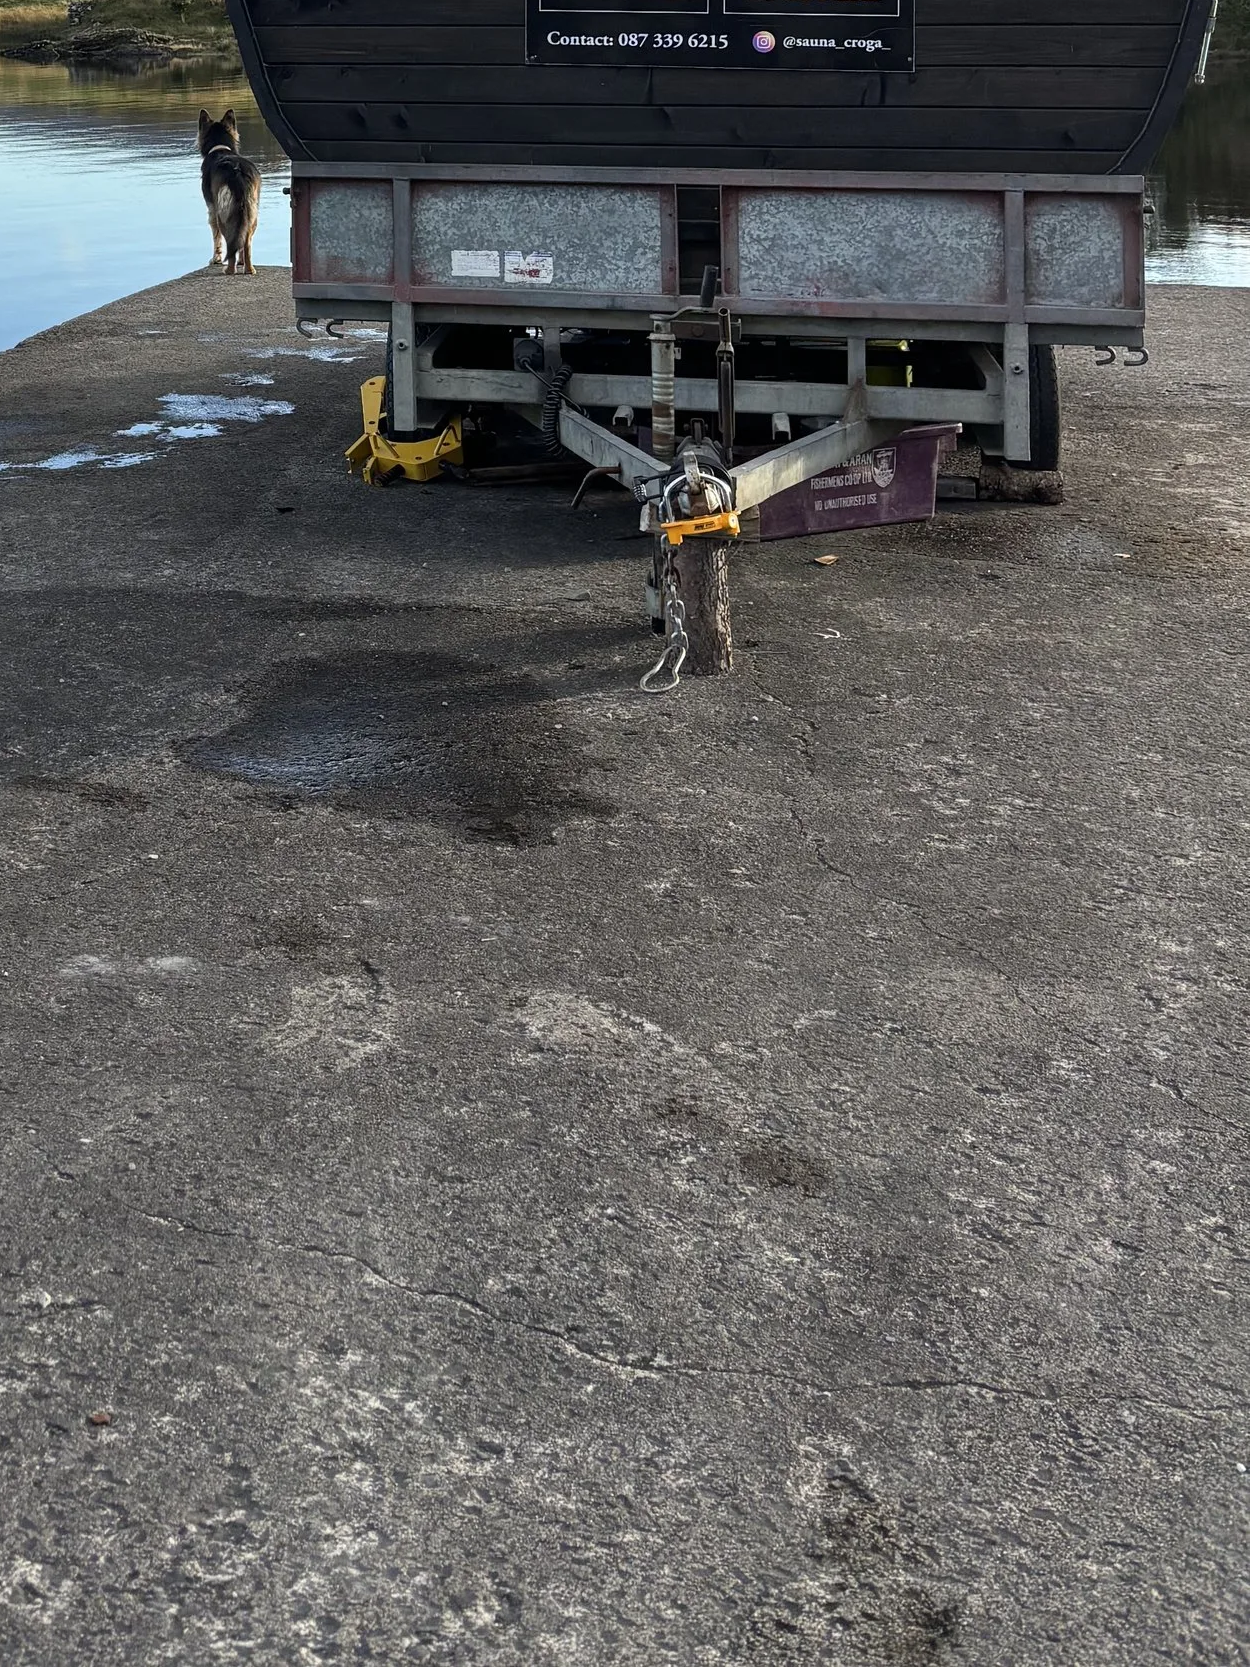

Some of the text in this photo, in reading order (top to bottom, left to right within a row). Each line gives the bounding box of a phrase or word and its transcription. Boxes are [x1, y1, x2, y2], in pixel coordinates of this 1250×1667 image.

[547, 31, 728, 49] Contact: 087 339 6215
[783, 36, 891, 52] @sauna_croga_
[850, 453, 872, 467] ARAN
[815, 493, 877, 511] NO UNAUTHORISED USE
